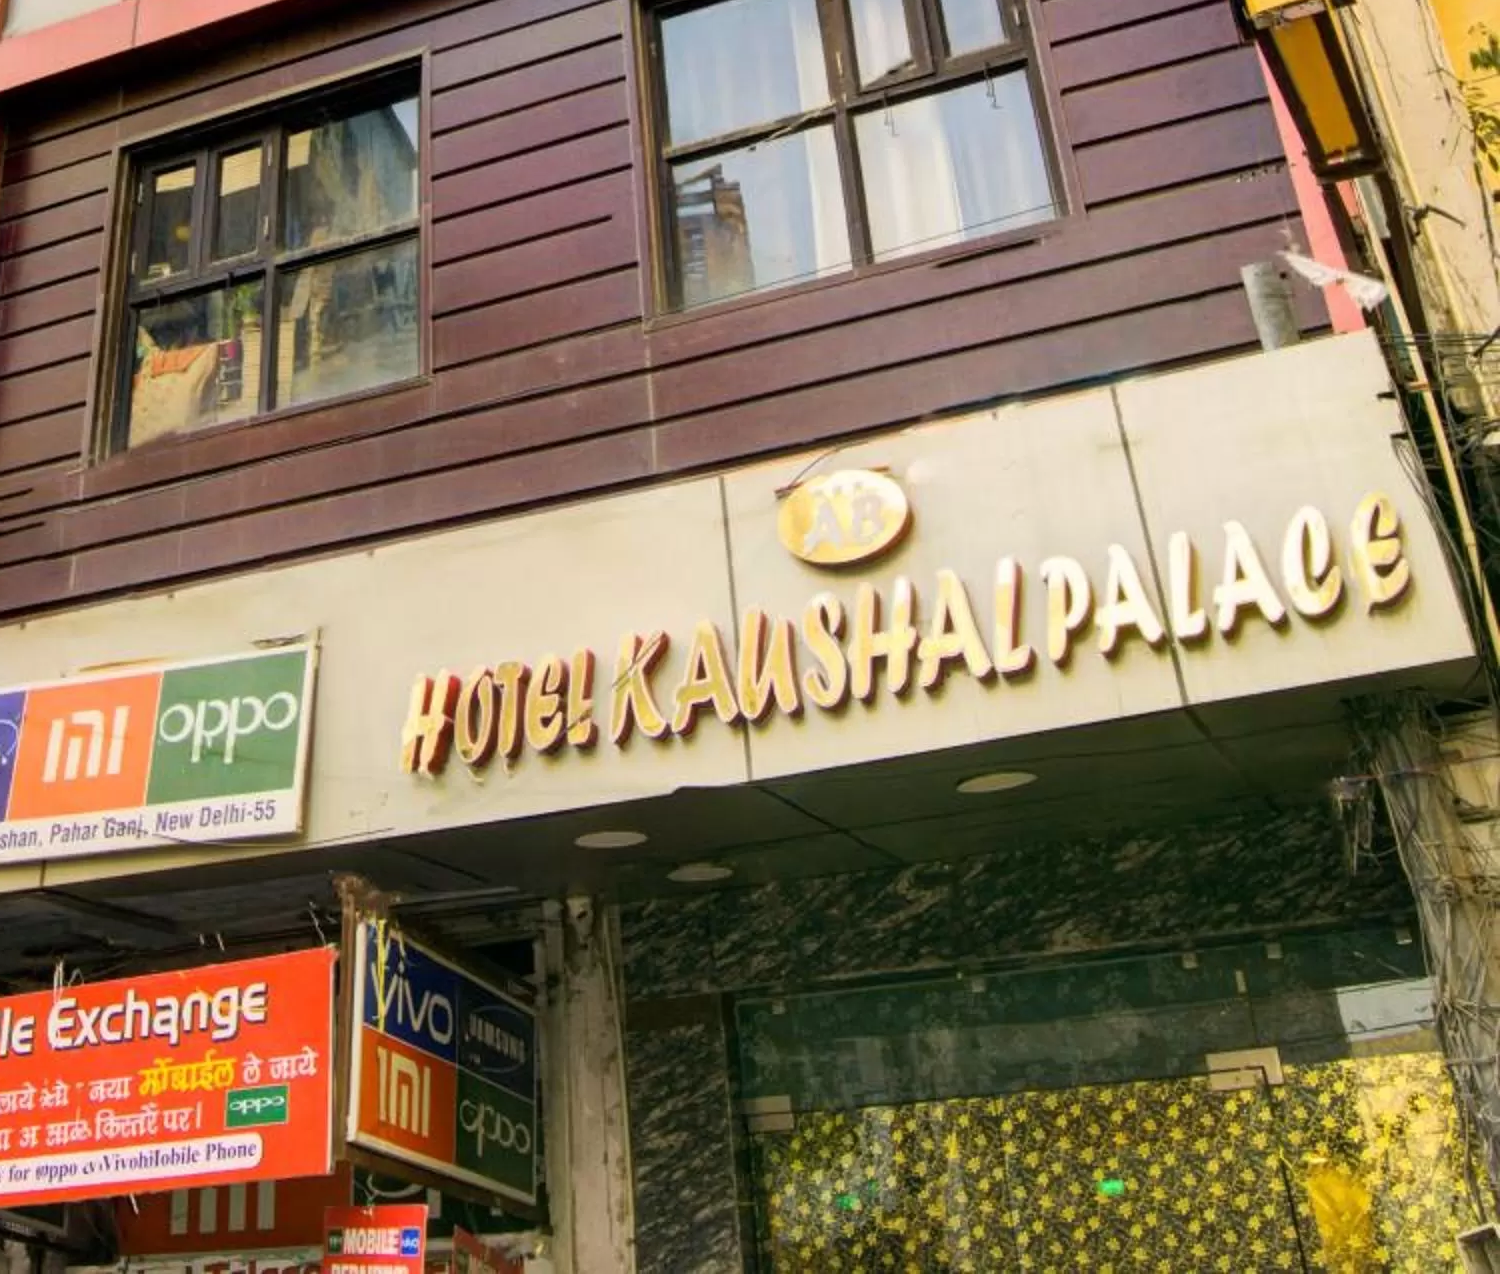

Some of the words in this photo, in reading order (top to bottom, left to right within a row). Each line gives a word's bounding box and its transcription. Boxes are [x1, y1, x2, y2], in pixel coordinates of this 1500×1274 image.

[49, 821, 98, 844] Pahar
[156, 810, 194, 832] New
[199, 798, 277, 828] Delhi-55
[8, 1163, 31, 1182] for
[205, 1135, 258, 1161] Phone
